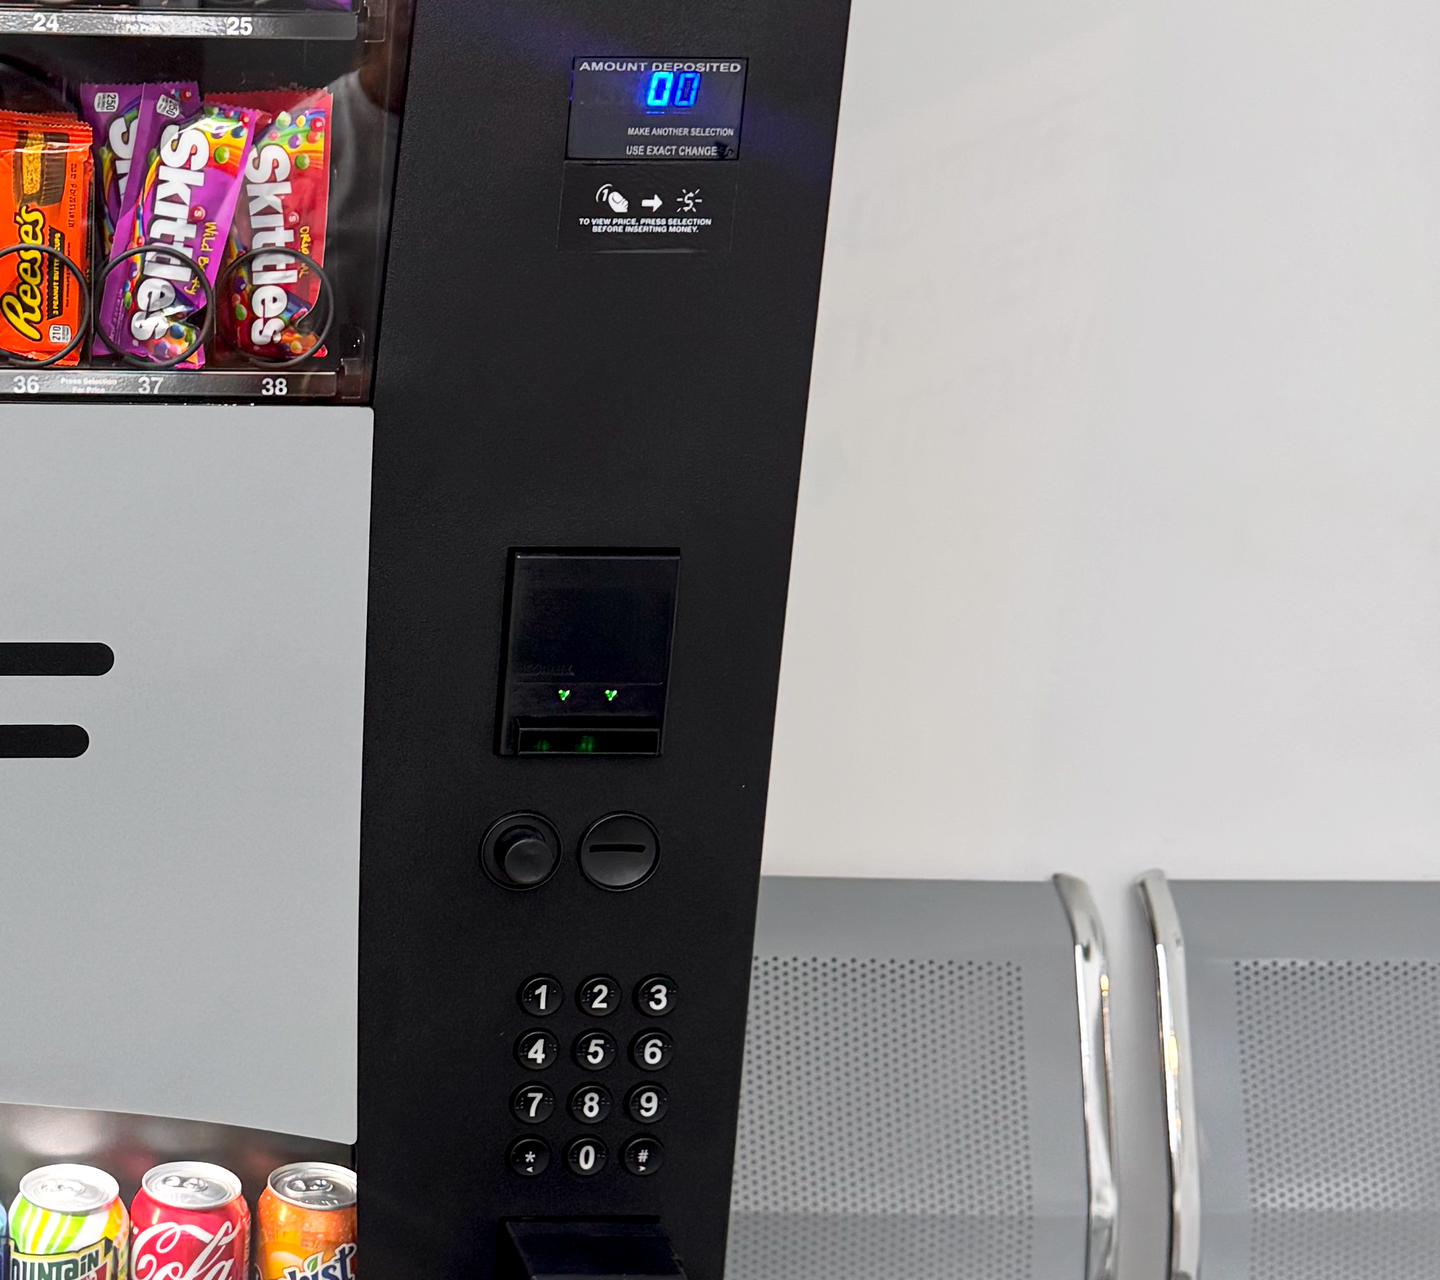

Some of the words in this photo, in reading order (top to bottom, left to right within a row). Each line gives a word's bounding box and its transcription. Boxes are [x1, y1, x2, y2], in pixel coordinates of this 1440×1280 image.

[32, 12, 59, 32] 24
[226, 16, 253, 36] 25
[578, 61, 649, 72] AMOUNT
[651, 61, 742, 74] DEPOSITED
[105, 93, 116, 111] 250
[627, 126, 651, 136] MAKE
[651, 127, 689, 137] ANOTHER
[690, 127, 735, 137] SELECTION
[626, 145, 645, 156] USE
[646, 145, 677, 156] EXACT
[678, 145, 718, 157] CHANGE
[130, 121, 211, 342] Skittles
[578, 217, 589, 226] TO
[591, 217, 612, 226] VIEW
[612, 217, 639, 227] PRICE,
[639, 217, 667, 226] PRESS
[667, 218, 712, 226] SELECTION
[591, 225, 624, 234] BEFORE
[625, 225, 667, 234] INSERTING
[668, 225, 700, 234] MONEY.
[200, 221, 220, 252] Wild
[245, 144, 299, 347] Skittles
[0, 205, 46, 343] Reese's
[51, 326, 61, 342] 210
[13, 376, 40, 394] 36
[137, 376, 164, 395] 37
[261, 378, 288, 396] 38
[534, 984, 548, 1010] 1
[591, 984, 609, 1009] 2
[648, 984, 668, 1011] 3
[527, 1038, 546, 1065] 4
[586, 1038, 605, 1065] 5
[643, 1038, 663, 1065] 6
[526, 1092, 544, 1118] 7
[582, 1092, 600, 1118] 8
[639, 1091, 659, 1118] 9
[578, 1145, 596, 1170] 0
[637, 1148, 649, 1163] #
